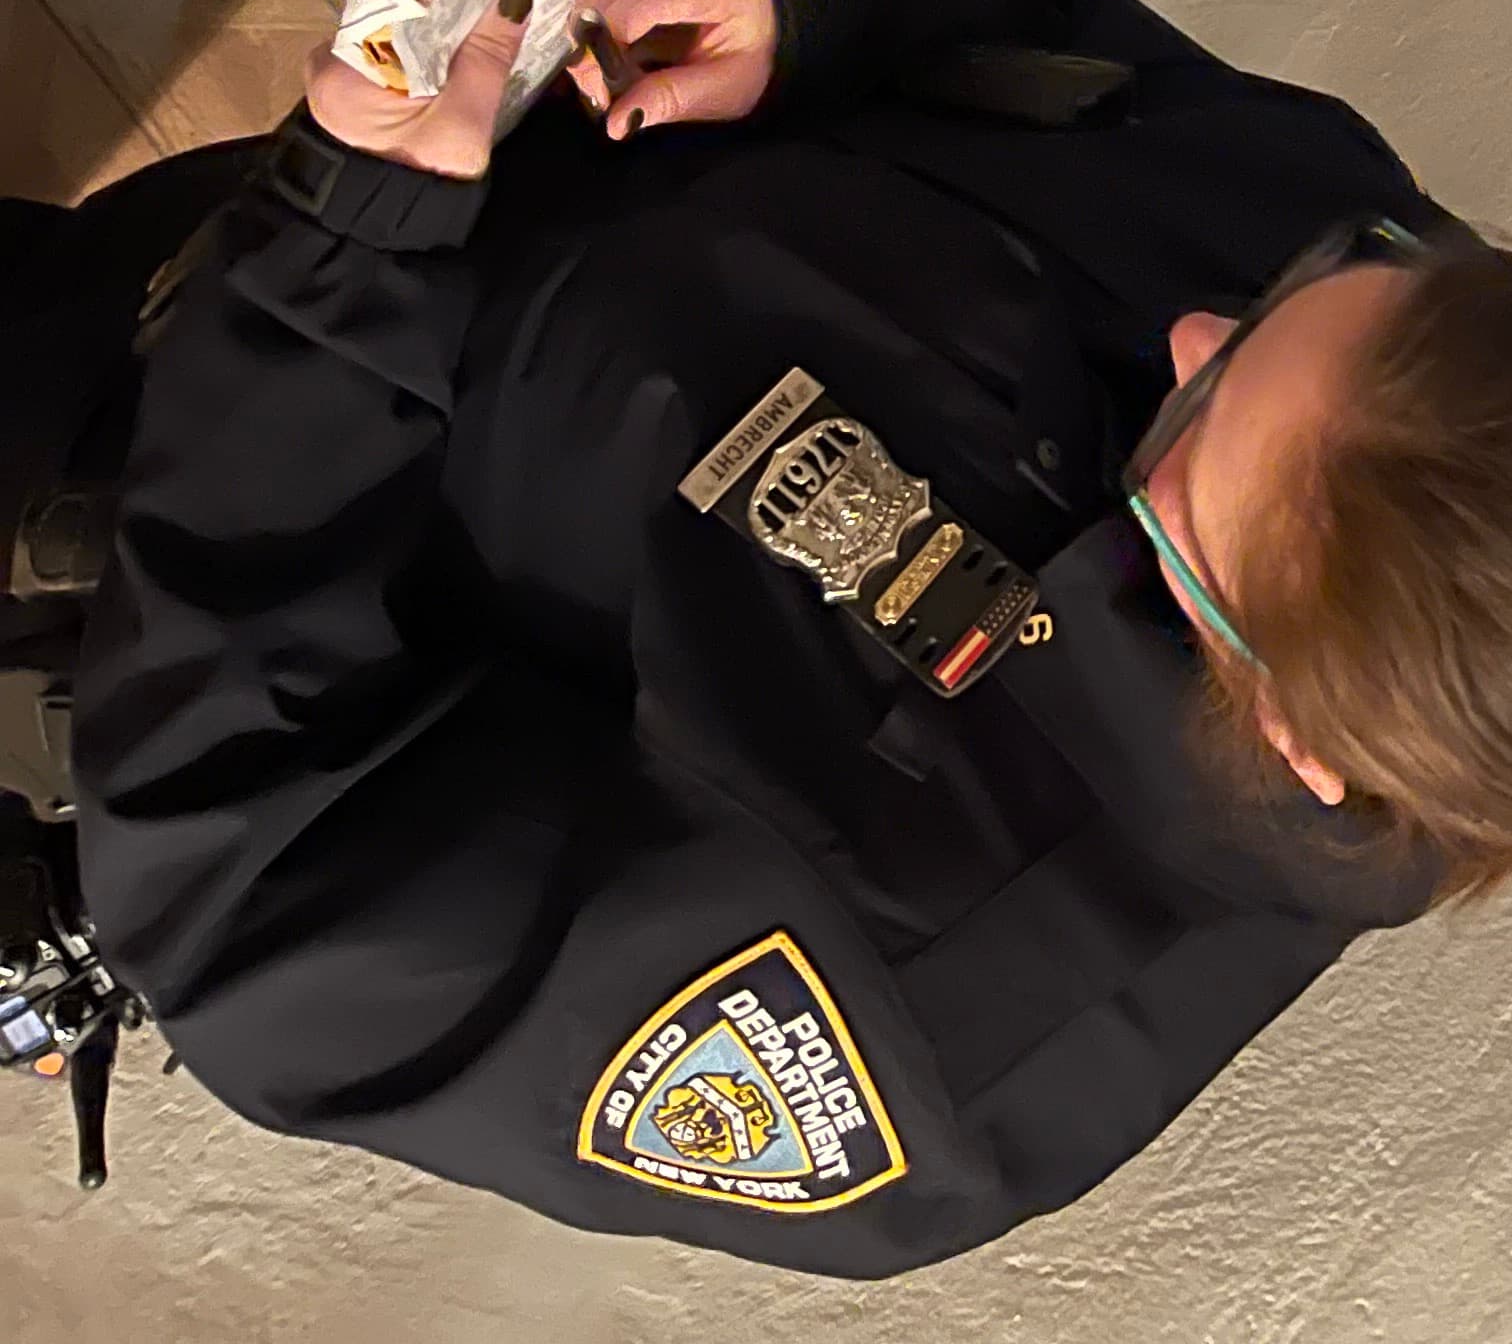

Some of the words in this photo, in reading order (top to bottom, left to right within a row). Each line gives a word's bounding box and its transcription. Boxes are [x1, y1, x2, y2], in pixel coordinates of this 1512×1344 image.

[708, 392, 794, 482] AMBRECHT
[756, 428, 853, 525] 17611
[625, 1022, 687, 1091] CITY
[718, 989, 851, 1180] DEPARTMENT
[782, 1011, 866, 1134] POLICE
[605, 1093, 635, 1129] OF
[634, 1157, 708, 1187] NEW
[709, 1177, 810, 1200] YORK
